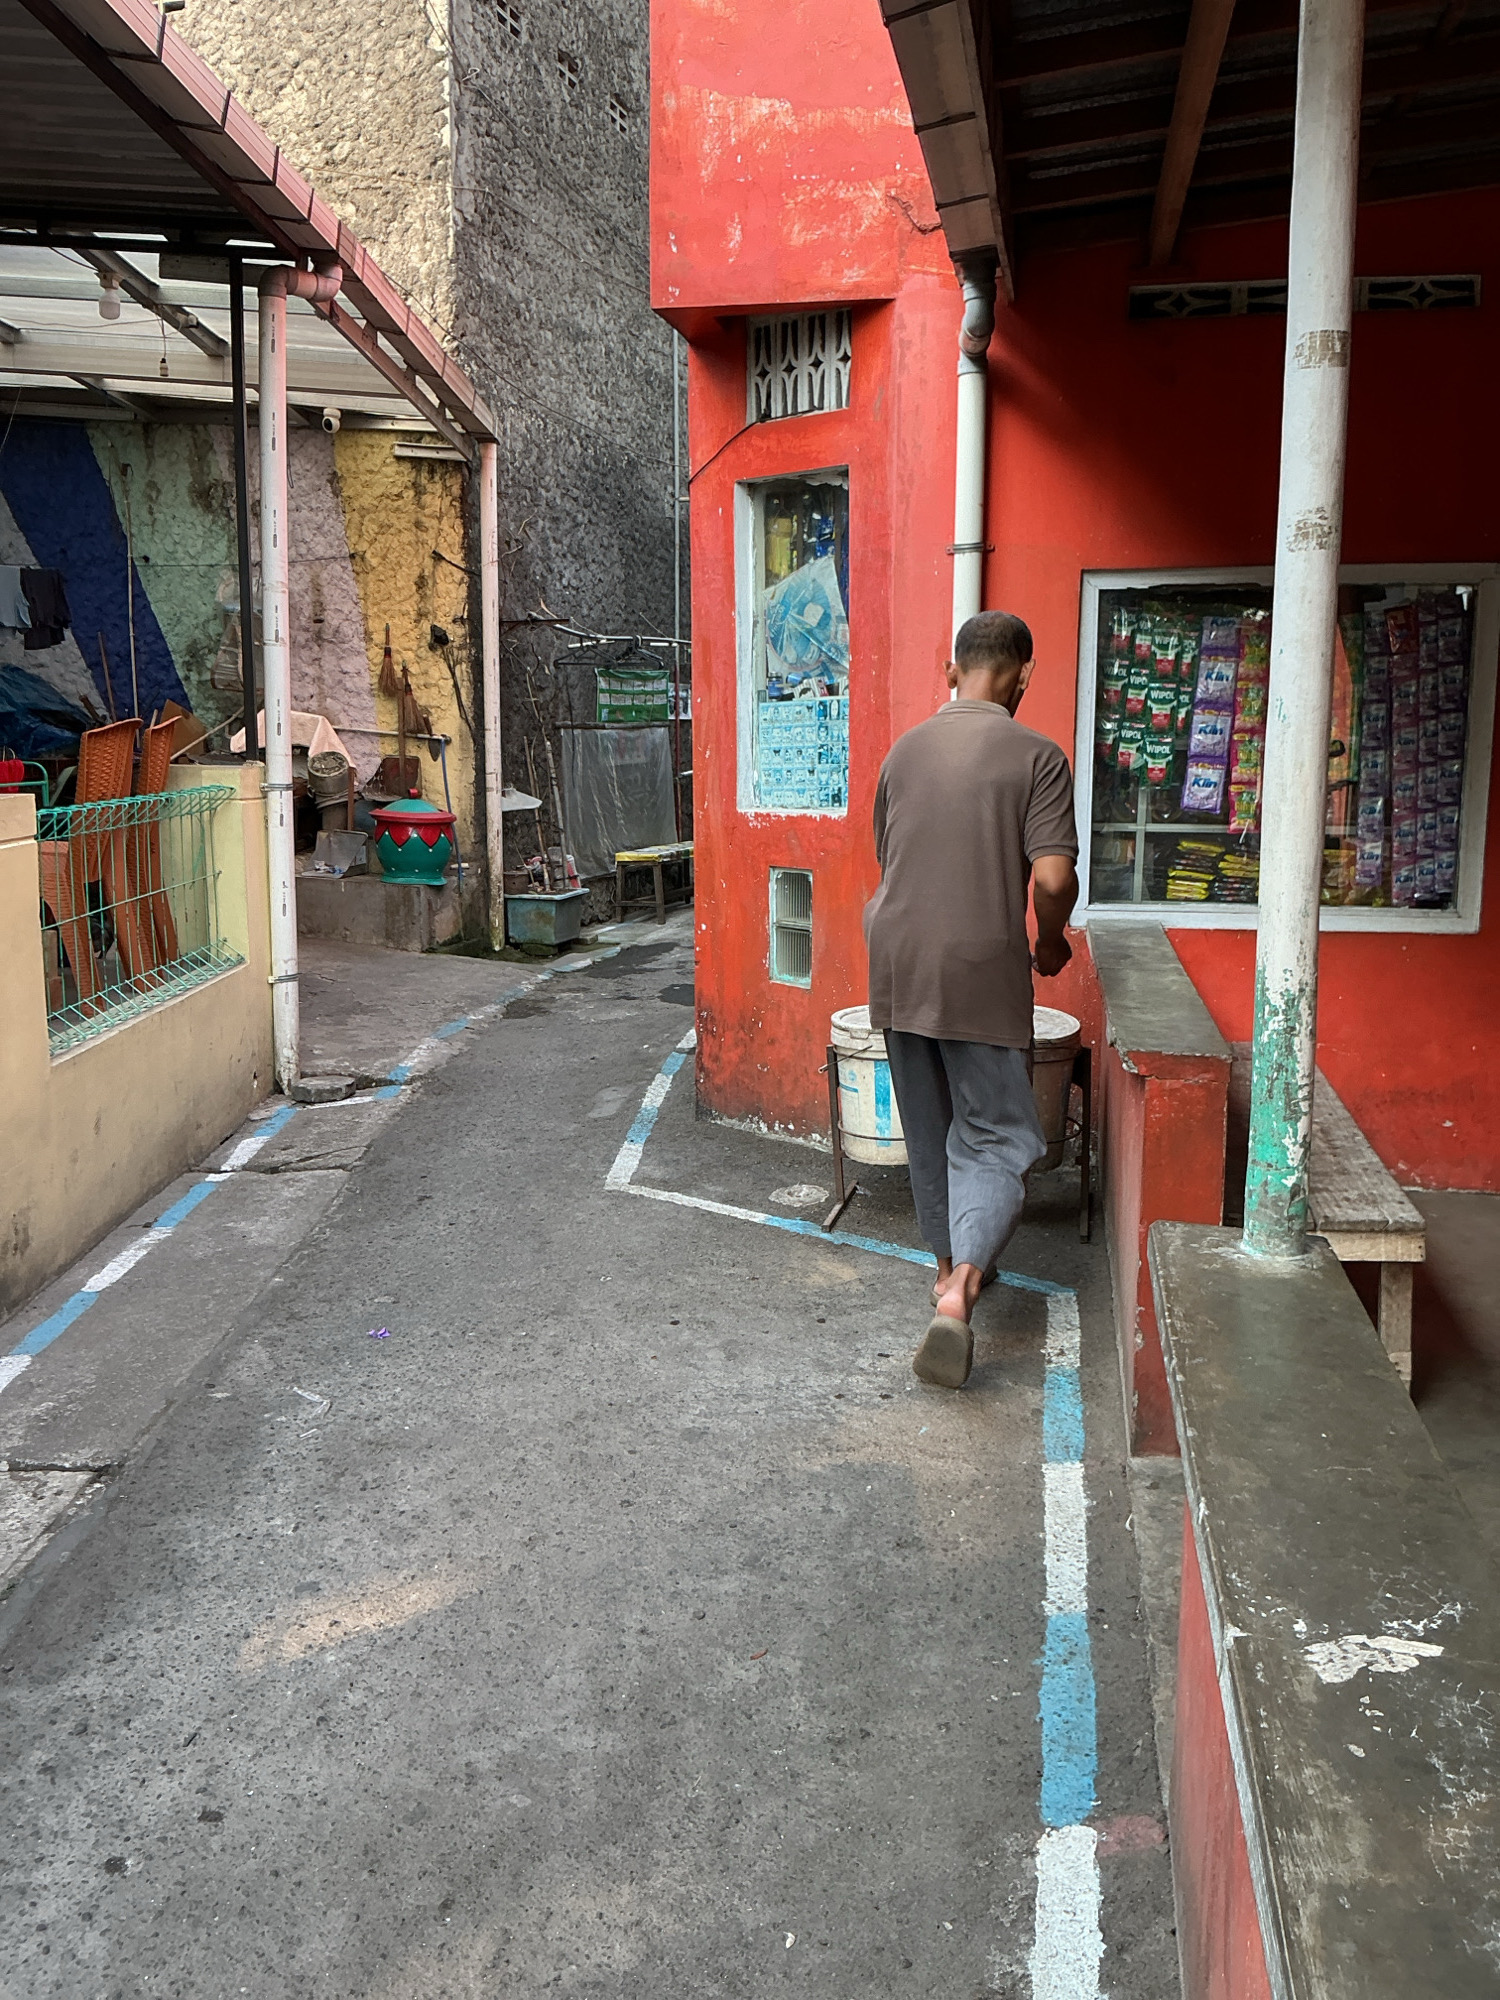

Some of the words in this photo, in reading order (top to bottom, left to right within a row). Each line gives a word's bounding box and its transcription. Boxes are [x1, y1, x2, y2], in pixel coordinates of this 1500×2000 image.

[1205, 671, 1230, 681] Klin
[1150, 690, 1175, 700] WIPOL
[1198, 724, 1224, 735] Klin
[1146, 742, 1171, 754] WIPOL
[1192, 778, 1218, 788] Klin
